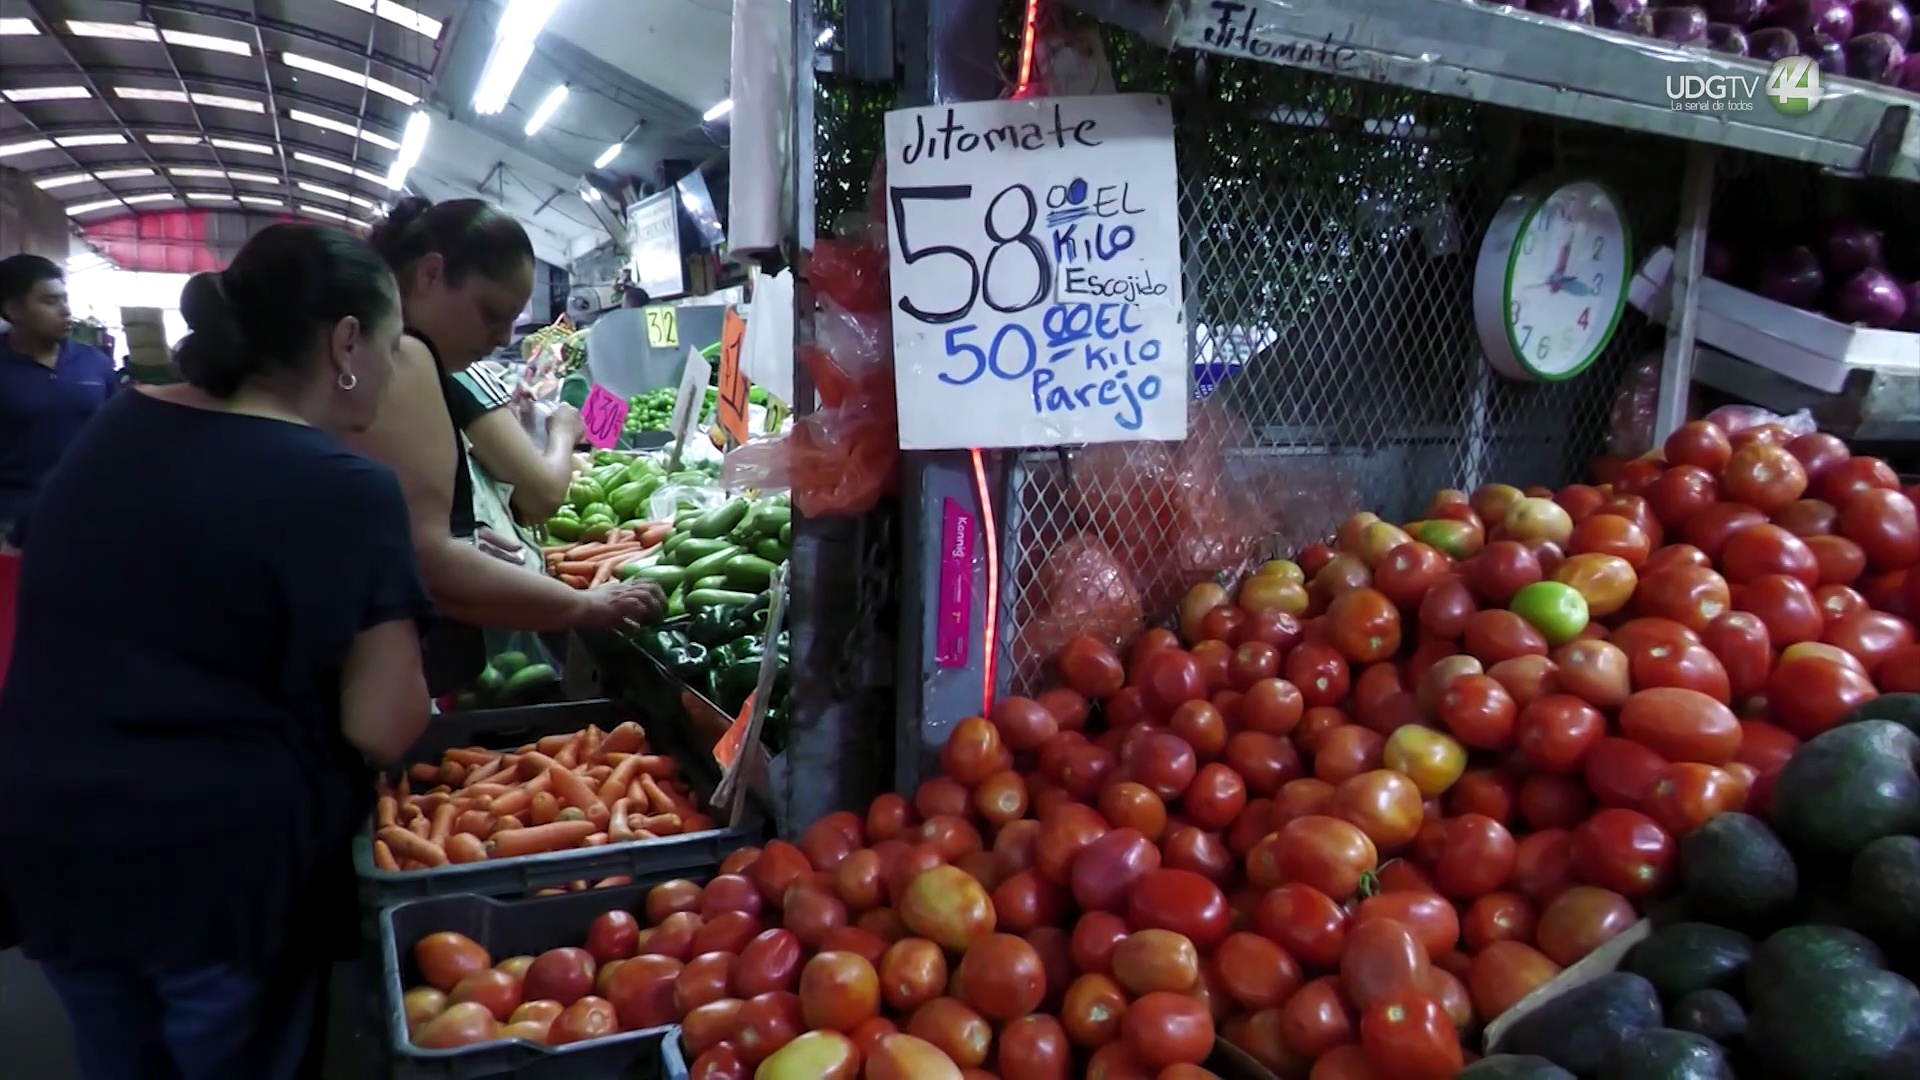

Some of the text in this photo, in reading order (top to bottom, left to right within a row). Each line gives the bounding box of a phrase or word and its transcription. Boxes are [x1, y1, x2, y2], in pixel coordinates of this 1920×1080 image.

[903, 104, 1104, 164] Jitomate
[890, 183, 1053, 324] 58
[1592, 236, 1605, 261] 2
[1065, 265, 1168, 303] Escojido
[1591, 272, 1604, 296] 3
[646, 311, 678, 344] 32
[1577, 307, 1591, 331] 4
[938, 323, 1038, 385] 50
[1520, 325, 1534, 352] 7
[1536, 336, 1551, 360] 6
[1031, 368, 1162, 430] Parejo
